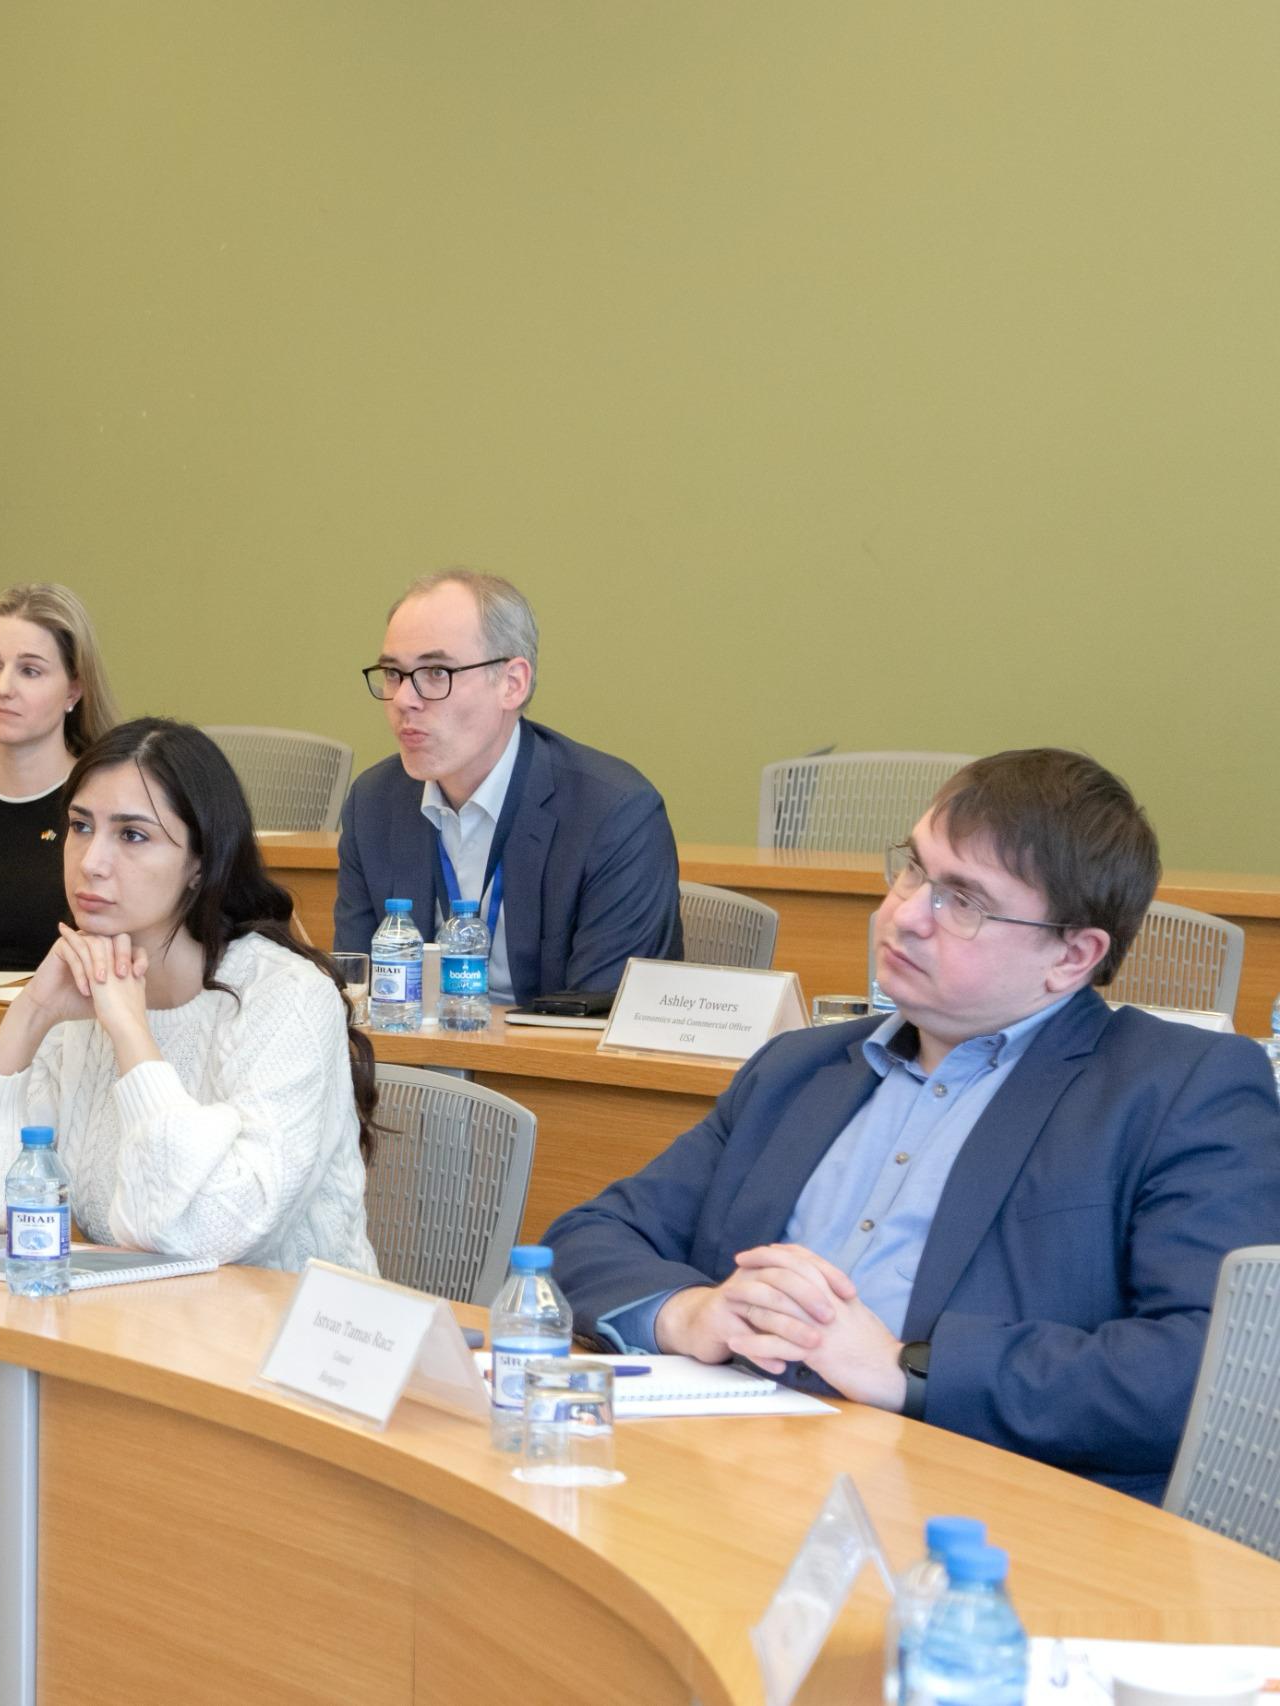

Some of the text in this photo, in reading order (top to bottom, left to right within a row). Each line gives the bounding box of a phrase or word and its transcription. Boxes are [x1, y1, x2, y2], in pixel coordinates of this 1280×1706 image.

[659, 993, 739, 1012] Ashley Towers
[672, 1016, 685, 1025] and
[686, 1018, 727, 1030] Commercial
[728, 1022, 752, 1032] Officer
[679, 1033, 696, 1043] USA
[312, 1310, 342, 1334] Istvan
